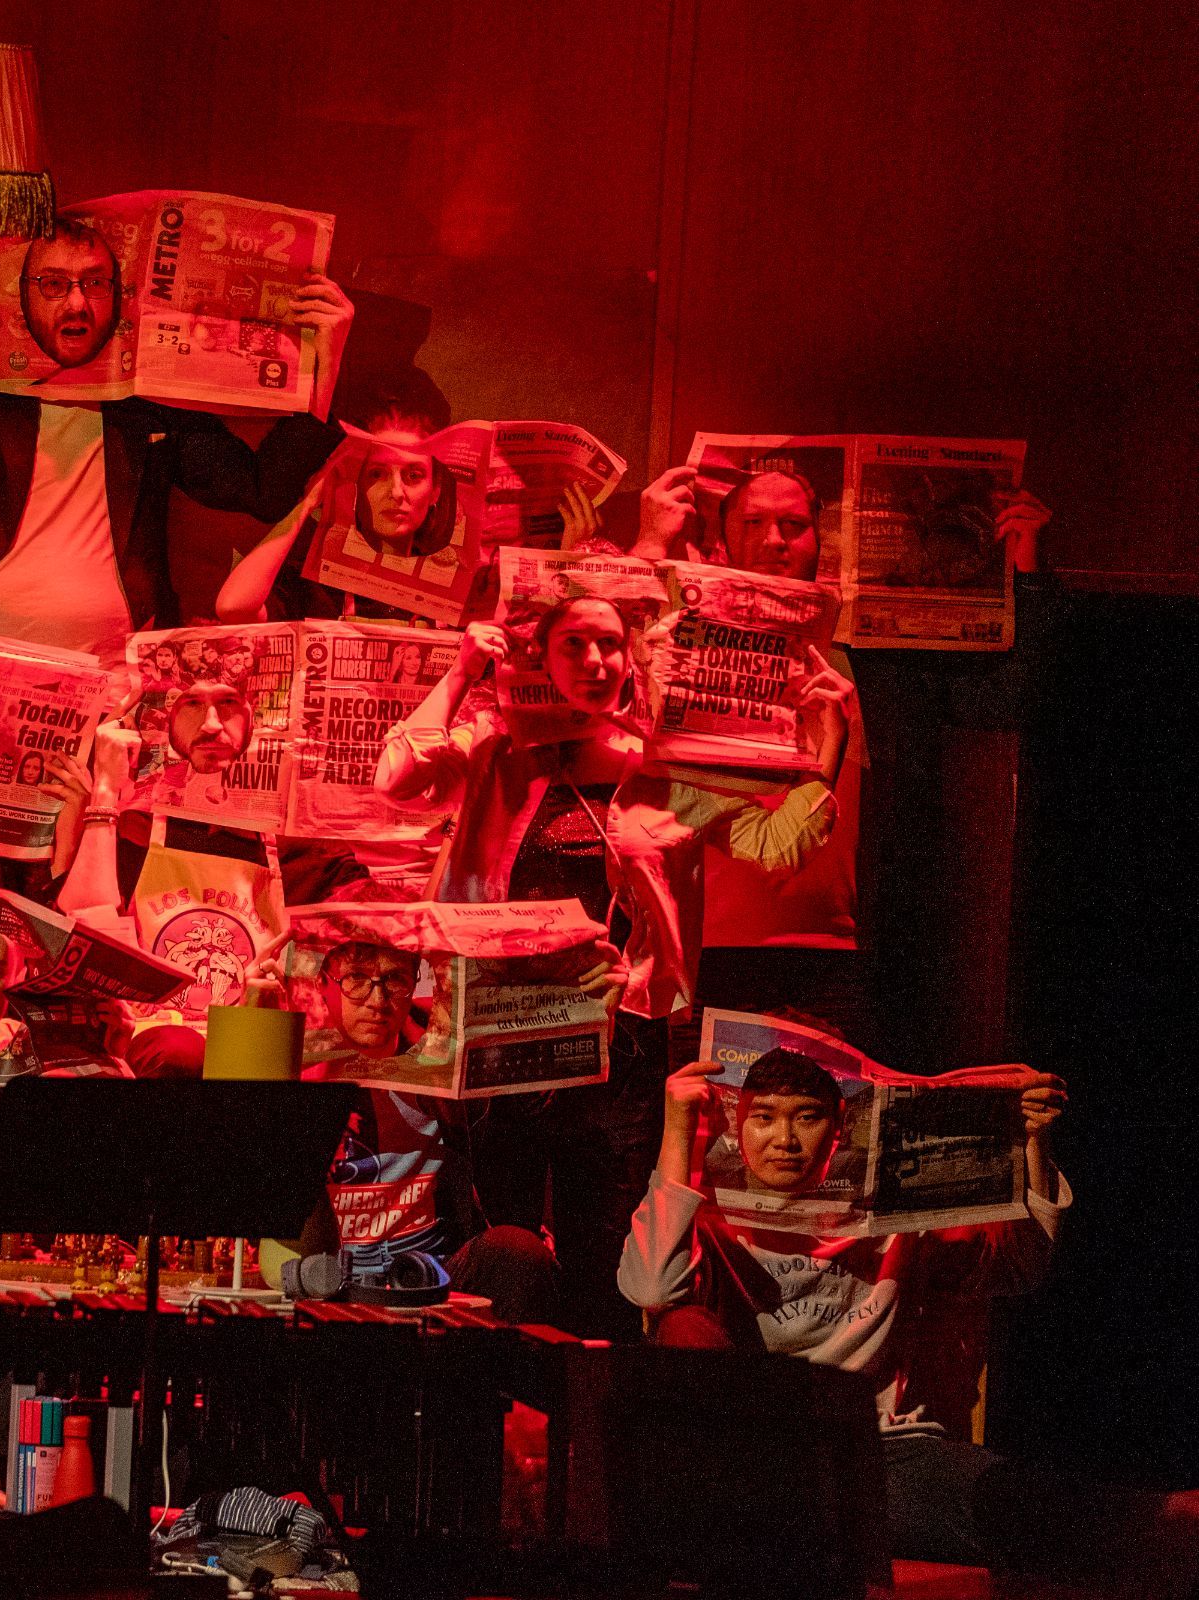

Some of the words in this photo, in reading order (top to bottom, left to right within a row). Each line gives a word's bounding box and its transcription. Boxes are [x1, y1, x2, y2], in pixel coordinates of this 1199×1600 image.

[200, 208, 228, 253] 3
[230, 229, 264, 254] for
[263, 220, 297, 264] 2
[150, 207, 185, 301] METRO
[210, 253, 269, 270] egg-cellent
[156, 333, 165, 344] 3
[171, 334, 179, 345] 2
[543, 429, 598, 454] Standard
[876, 443, 929, 460] Evening
[307, 635, 327, 643] .co.uk
[366, 640, 389, 660] AND
[259, 655, 292, 673] RIVALS
[433, 650, 457, 662] STORY
[698, 645, 769, 676] TOXINS'
[769, 658, 790, 681] IN
[333, 658, 372, 680] ARREST
[79, 685, 105, 696] STORY
[281, 674, 291, 690] IT
[302, 643, 329, 738] METRO
[694, 668, 733, 694] OUR
[734, 674, 789, 702] FRUIT
[16, 698, 90, 734] Totally
[328, 696, 404, 721] RECORD
[689, 695, 732, 715] AND
[737, 697, 773, 722] VEG
[16, 724, 83, 757] failed
[257, 737, 286, 765] OFF
[220, 763, 280, 792] KALVIN
[9, 810, 26, 820] WORK
[26, 813, 39, 822] FOR
[147, 887, 191, 916] LOS
[453, 906, 504, 918] Evening
[474, 997, 519, 1016] London's
[520, 990, 589, 1011] £2,000-a-year
[497, 1017, 513, 1031] tax
[513, 1009, 571, 1028] bombshell
[553, 1039, 595, 1056] USHER
[767, 1256, 821, 1279] LOOK
[772, 1301, 808, 1326] FLY!
[847, 1300, 879, 1325] FLY!
